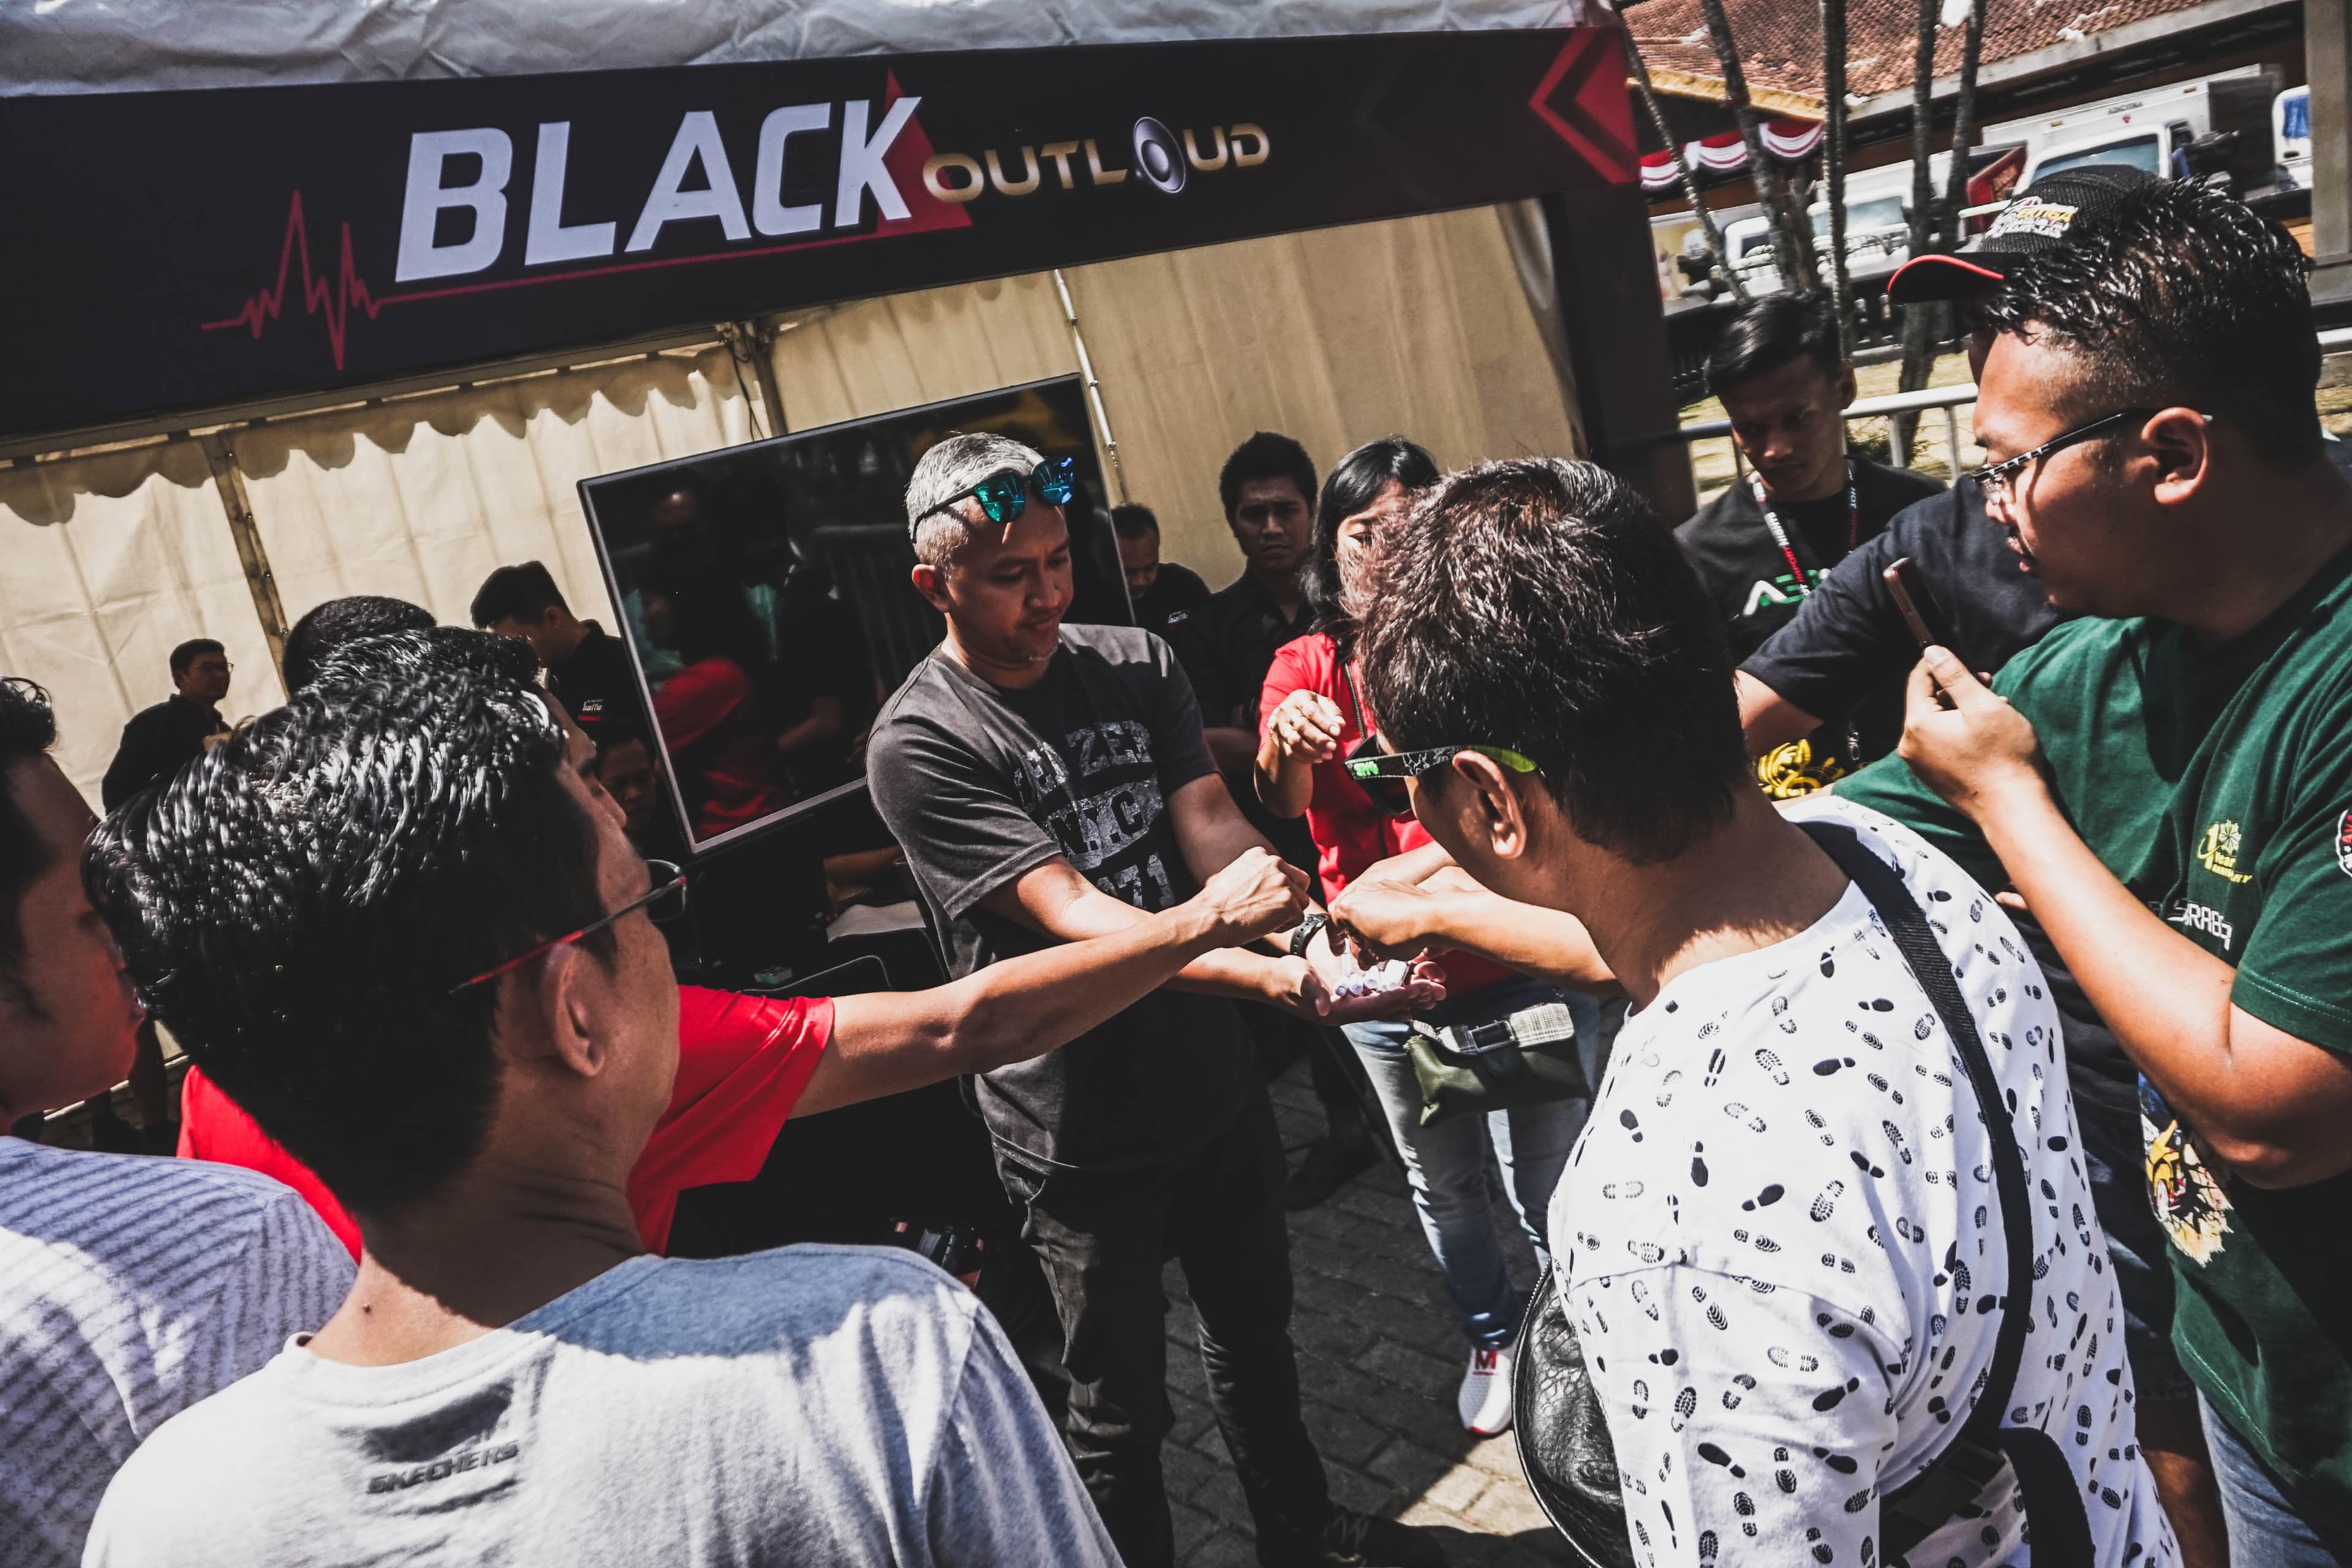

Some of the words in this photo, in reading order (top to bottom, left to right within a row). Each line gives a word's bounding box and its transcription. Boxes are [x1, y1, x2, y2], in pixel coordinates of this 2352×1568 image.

[395, 96, 923, 282] BLACK
[922, 116, 1270, 203] OUTLOUD
[366, 1441, 519, 1494] SKECHERS
